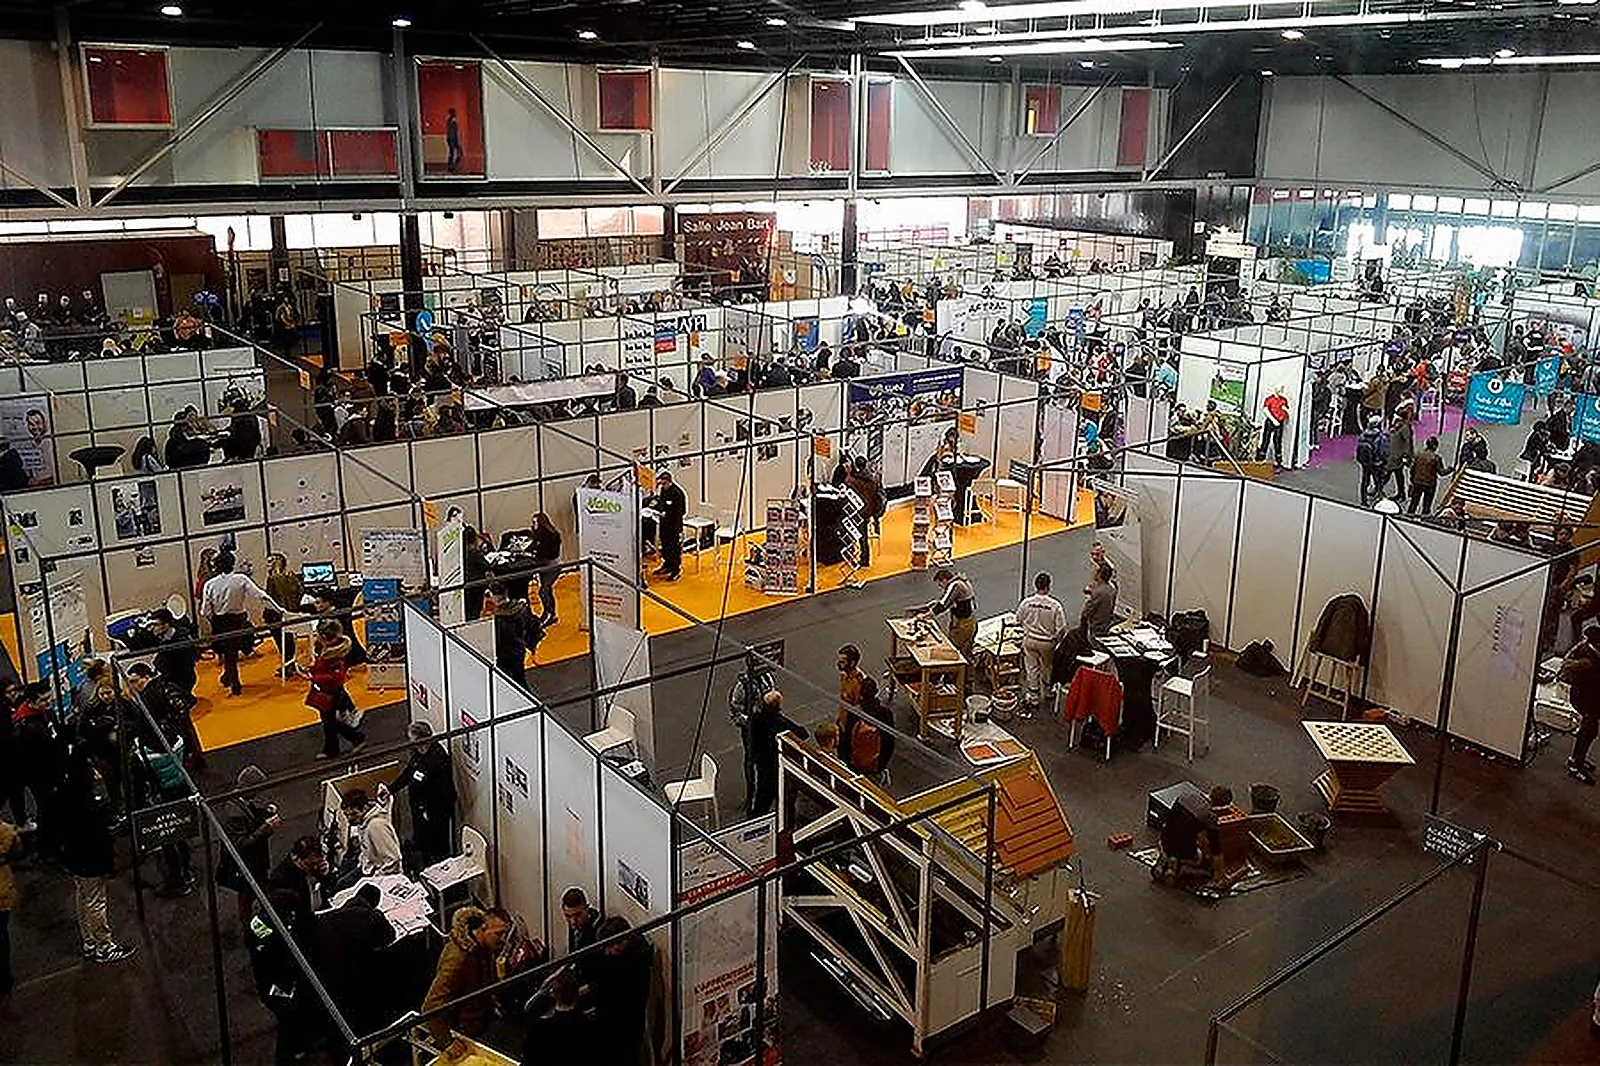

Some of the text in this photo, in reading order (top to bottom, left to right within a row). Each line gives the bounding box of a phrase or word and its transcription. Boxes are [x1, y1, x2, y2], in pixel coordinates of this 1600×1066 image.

[683, 217, 770, 234] Salle Jean Bart
[587, 497, 624, 513] Valeo
